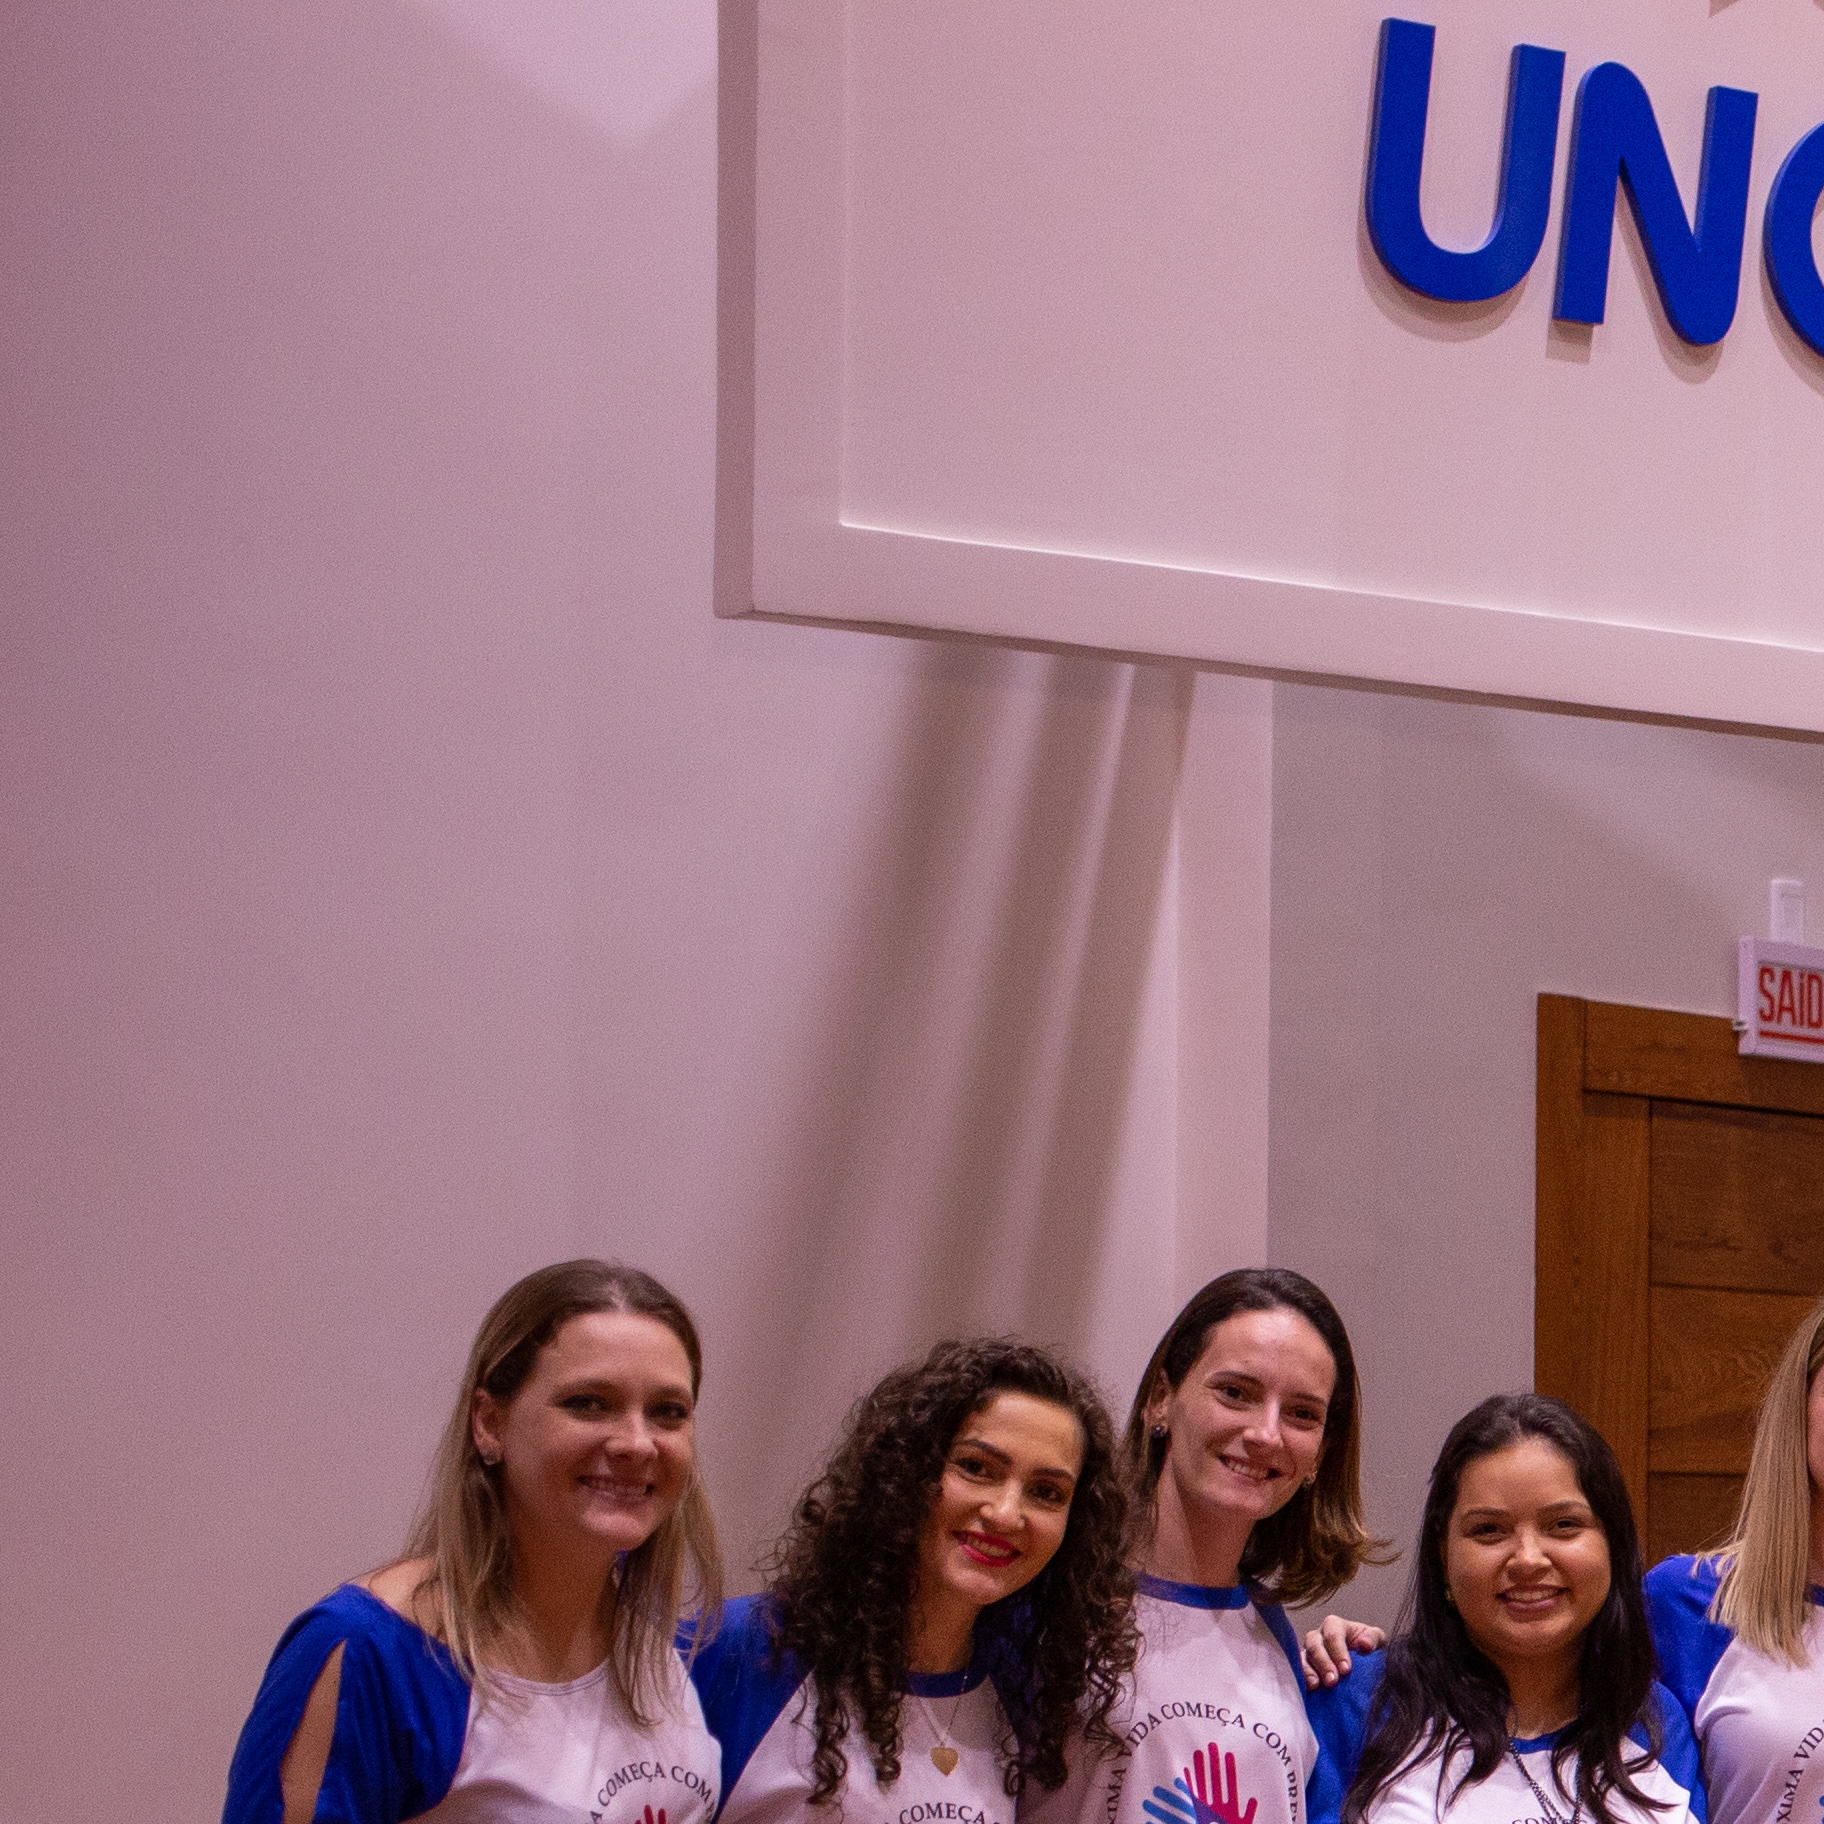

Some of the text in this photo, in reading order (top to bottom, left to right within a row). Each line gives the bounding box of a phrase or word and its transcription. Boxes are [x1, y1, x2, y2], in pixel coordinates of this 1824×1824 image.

[1161, 1701, 1246, 1729] COMEÇA
[1252, 1721, 1293, 1767] COM
[597, 1761, 667, 1807] COMEÇA
[671, 1765, 713, 1803] COM
